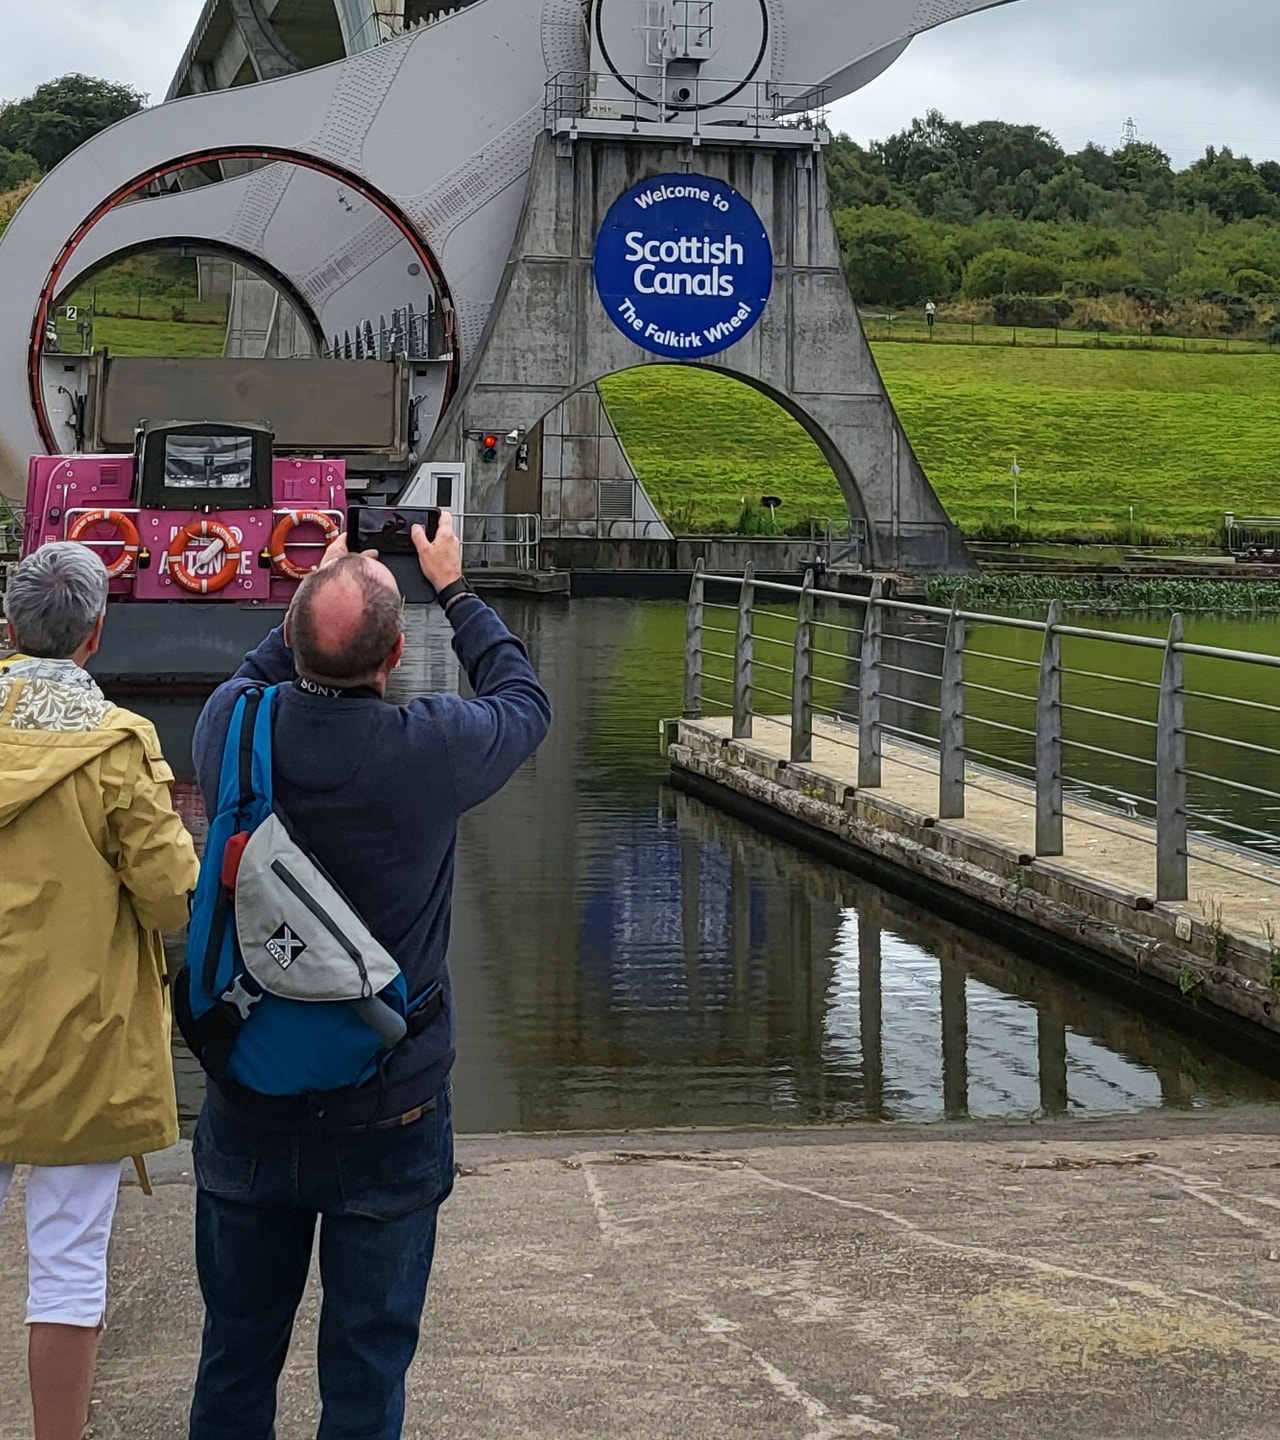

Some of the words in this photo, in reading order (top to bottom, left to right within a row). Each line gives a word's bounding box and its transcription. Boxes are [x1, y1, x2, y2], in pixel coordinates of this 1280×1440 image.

[634, 185, 710, 210] Welcome
[712, 195, 730, 212] to
[625, 231, 744, 265] Scottish
[633, 264, 734, 296] Canals
[67, 307, 76, 320] 2
[618, 297, 644, 331] The
[644, 323, 703, 348] Falkirk
[703, 301, 752, 343] Wheel
[301, 677, 342, 698] SONY
[268, 942, 289, 965] over
